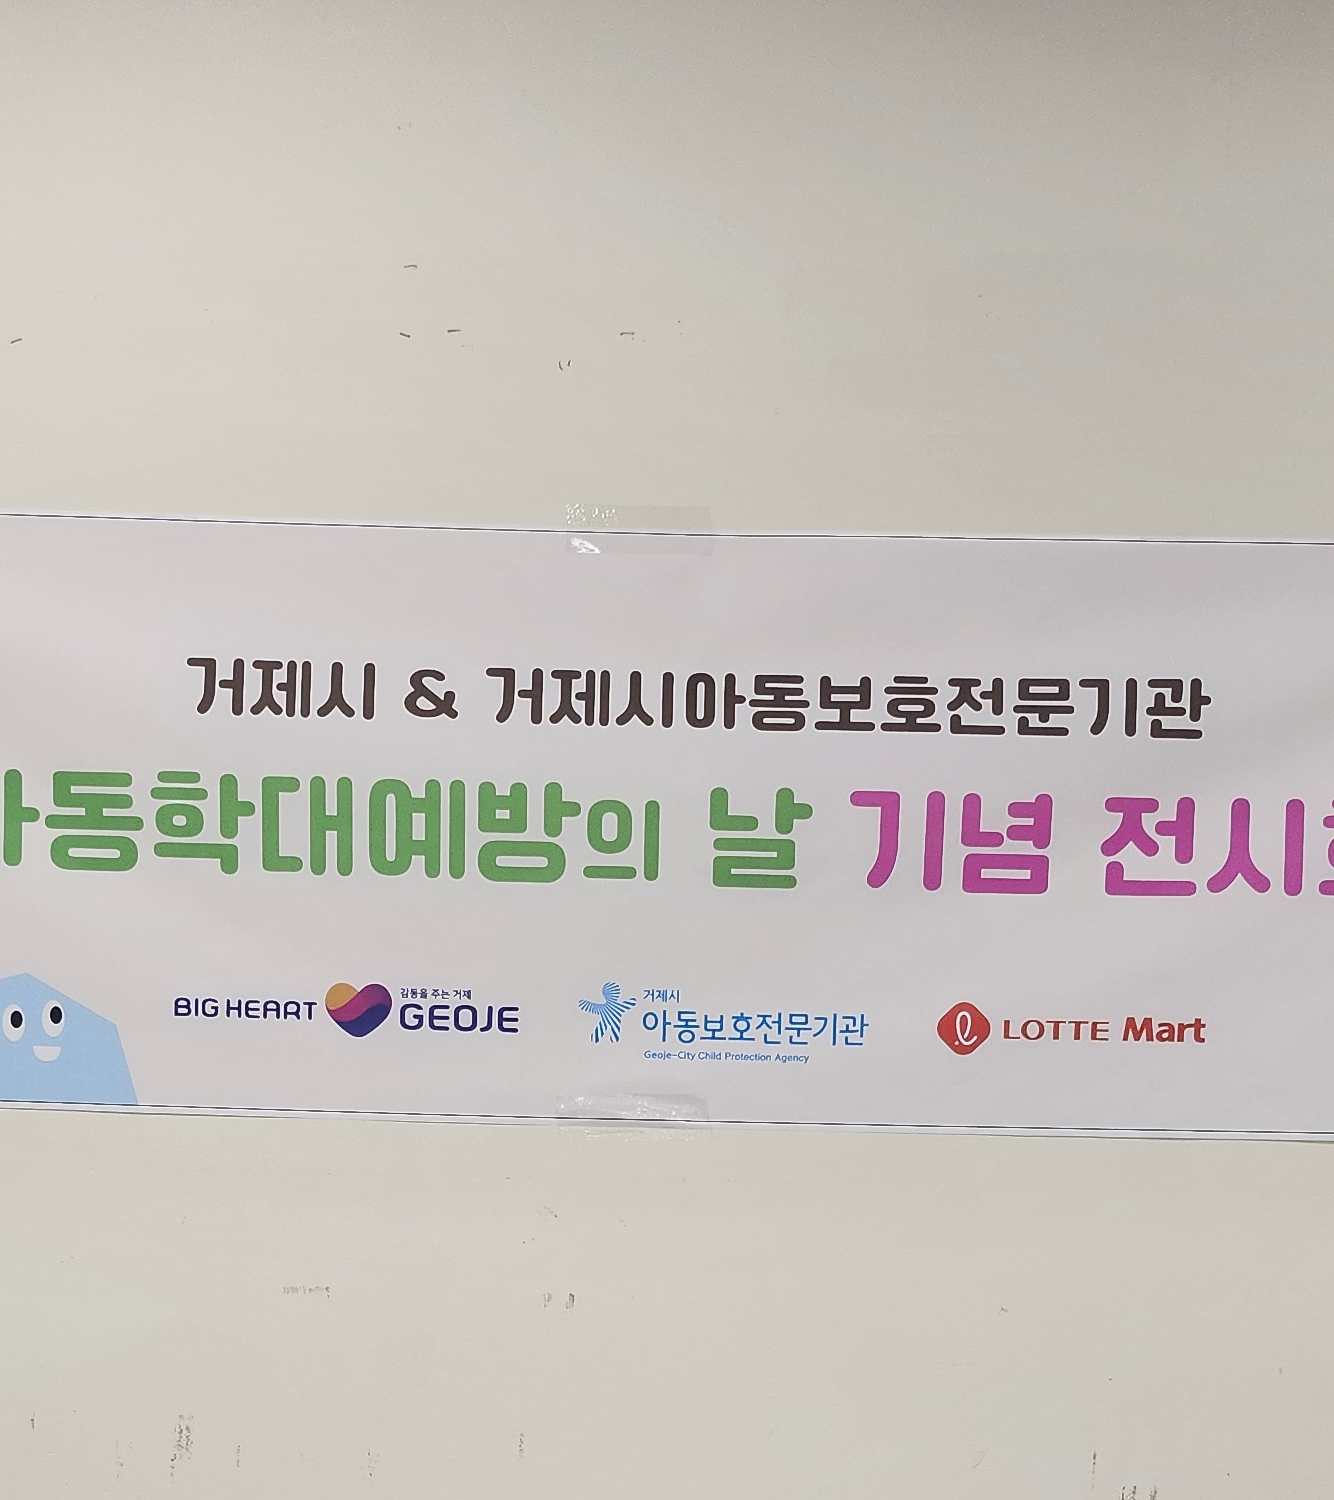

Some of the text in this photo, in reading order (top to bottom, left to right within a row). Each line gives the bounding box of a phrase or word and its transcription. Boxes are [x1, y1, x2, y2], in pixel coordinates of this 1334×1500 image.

[186, 657, 1212, 740] 거제시 & 거제시아동보호전문기관
[709, 786, 814, 889] 날
[849, 790, 1054, 895] 기념
[400, 987, 473, 1001] 감동을 주는 거제
[642, 988, 680, 1004] 거제시
[174, 997, 318, 1021] BIG HEART
[399, 1003, 520, 1034] GEOJE
[642, 1009, 870, 1047] 아동보호전문기관
[1003, 1016, 1207, 1043] LOTTE Mart
[643, 1050, 810, 1065] Geoje-City Child Protection Agency
